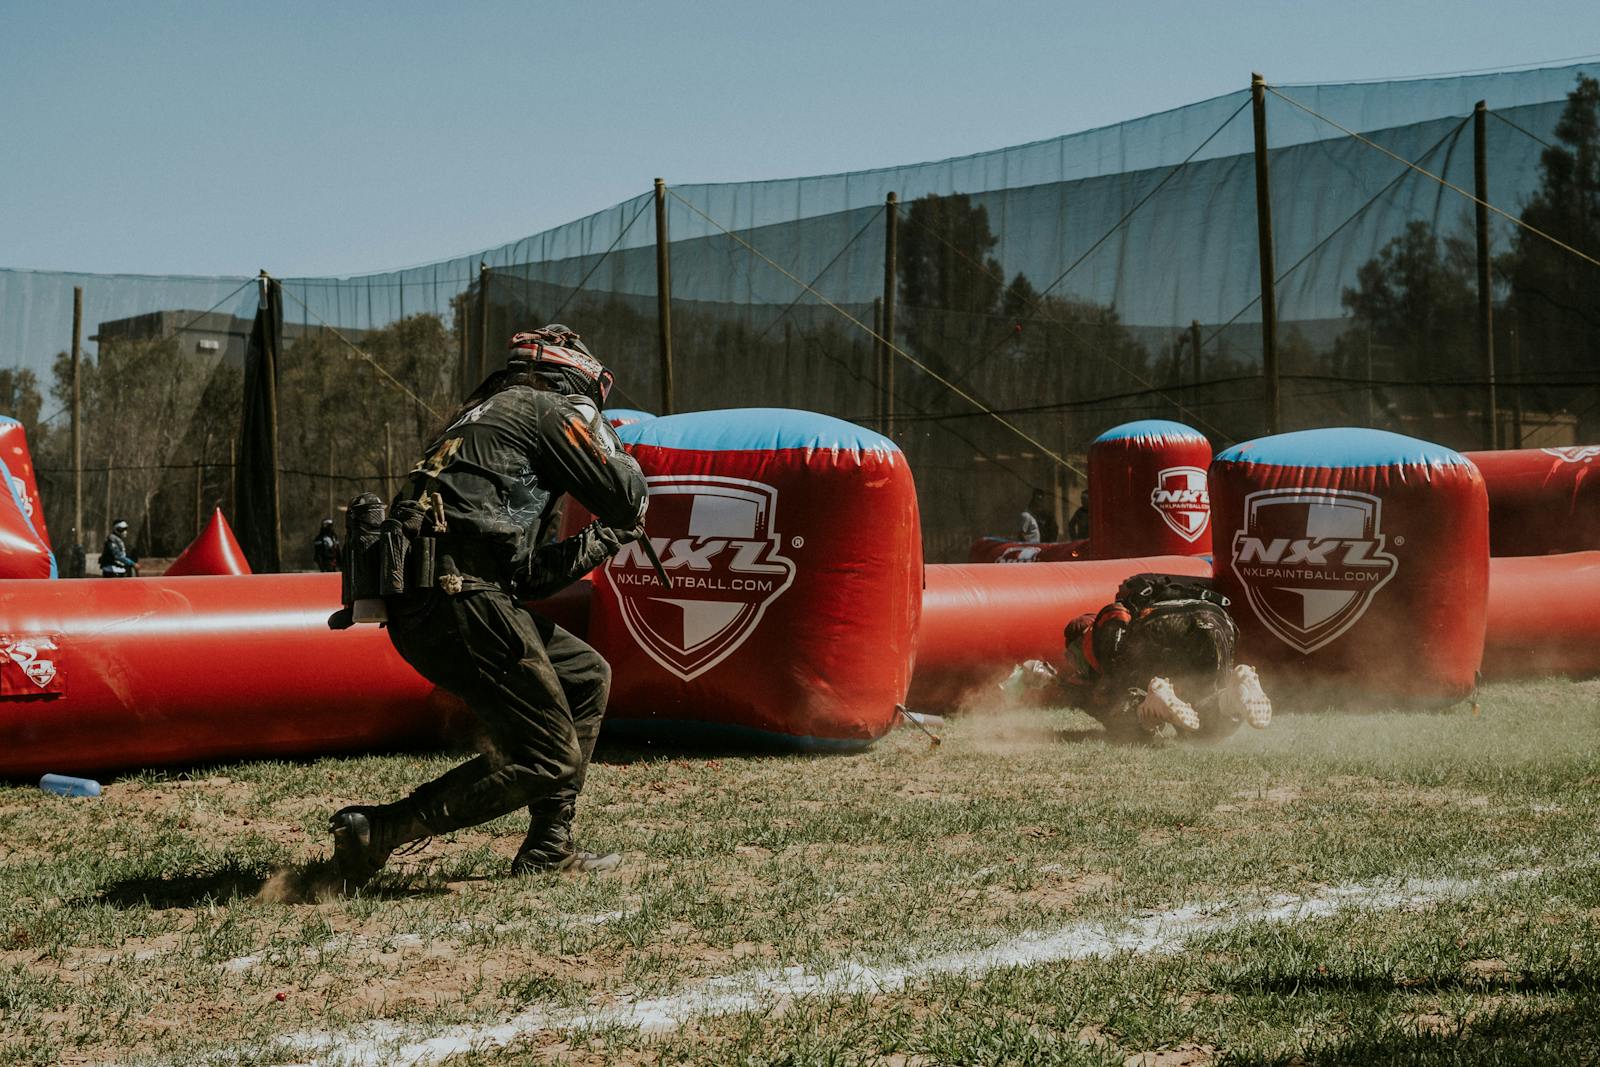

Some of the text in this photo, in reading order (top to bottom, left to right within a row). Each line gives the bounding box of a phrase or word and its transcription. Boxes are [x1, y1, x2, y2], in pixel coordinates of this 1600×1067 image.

[611, 537, 787, 575] NXL
[1237, 537, 1392, 567] NXL
[616, 573, 773, 592] NXLPATBALL.COM
[1243, 567, 1380, 582] NXLPAINTBALL.COM
